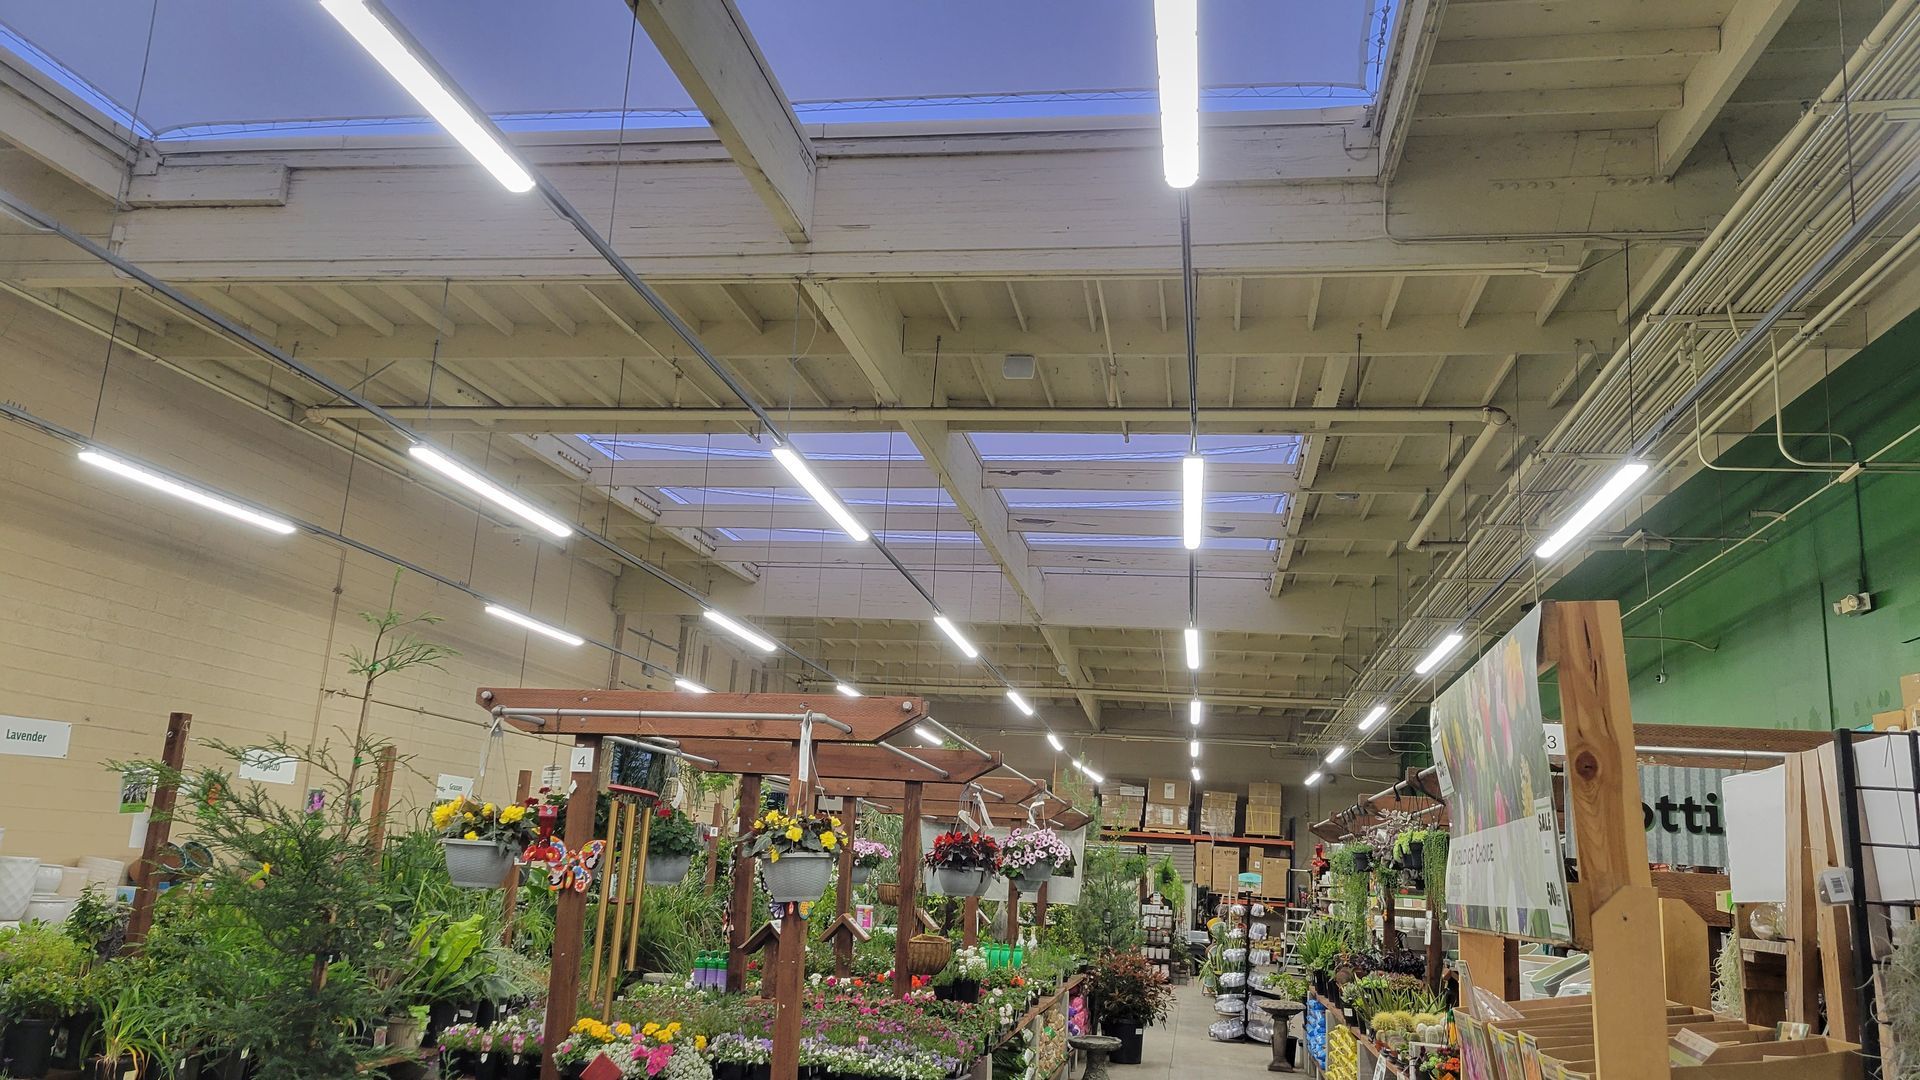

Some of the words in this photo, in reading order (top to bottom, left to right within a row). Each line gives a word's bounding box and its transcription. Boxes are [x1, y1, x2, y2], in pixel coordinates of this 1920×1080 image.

[6, 729, 47, 742] Lavender
[1547, 735, 1557, 749] 3
[577, 755, 586, 768] 4
[1538, 812, 1552, 832] SALE
